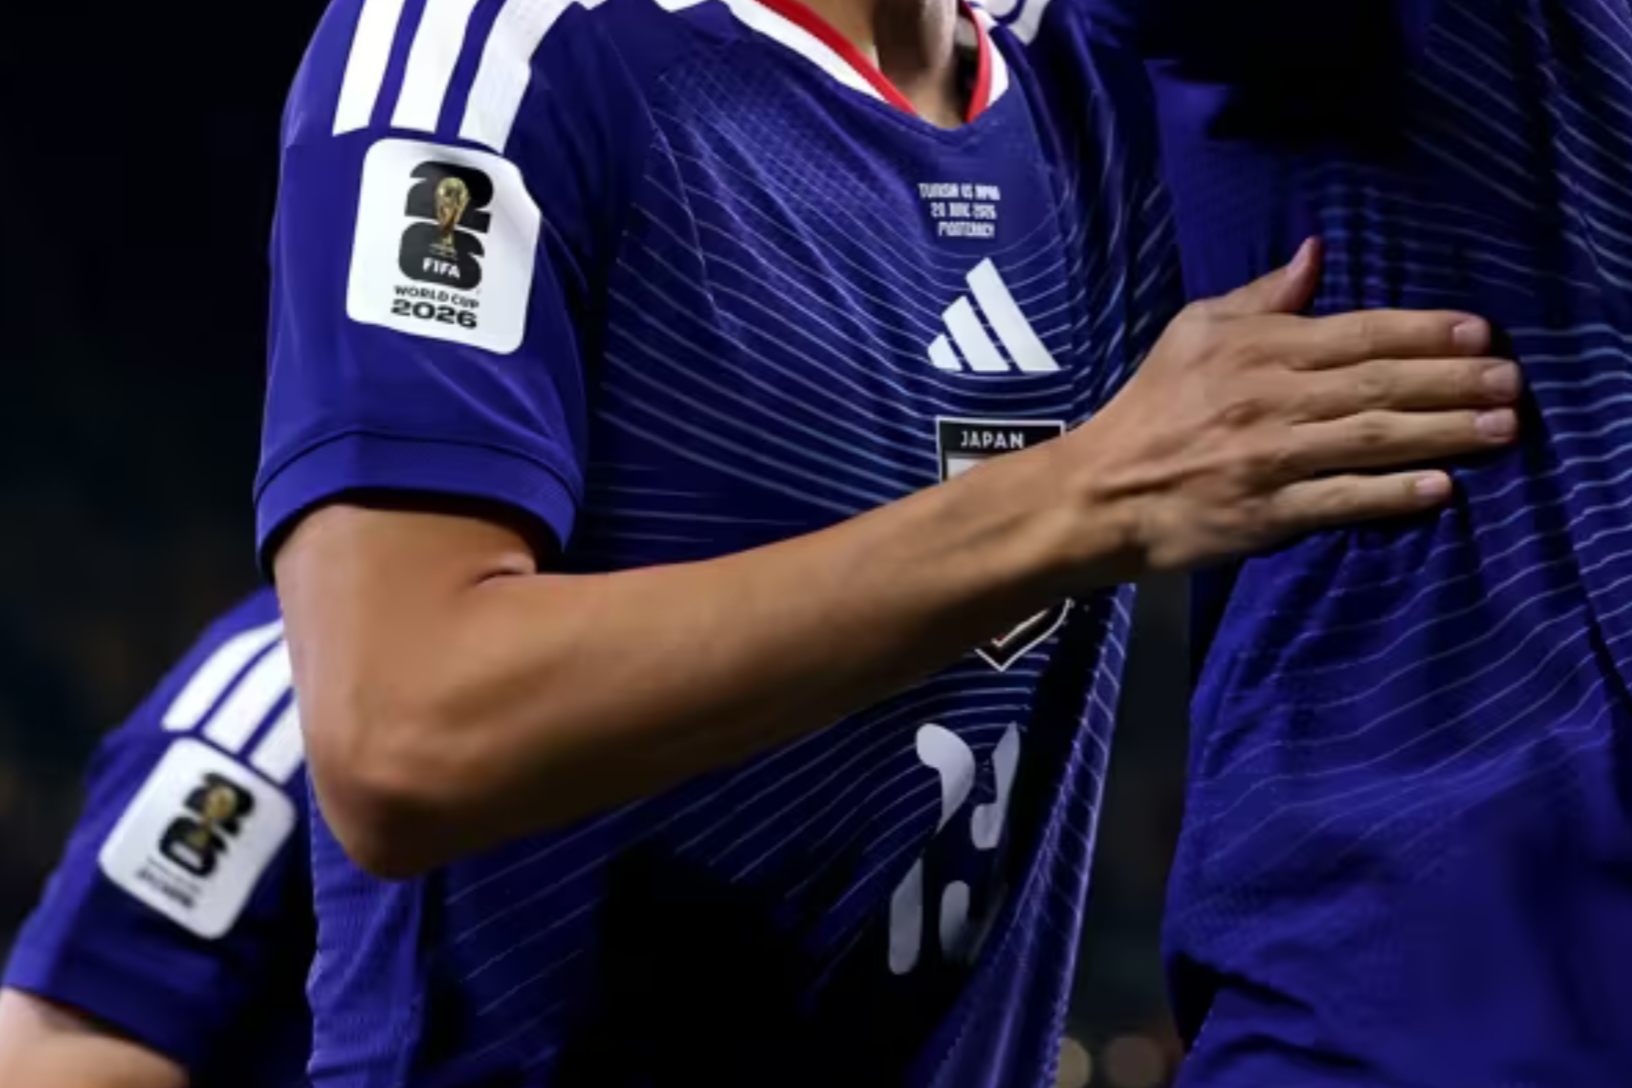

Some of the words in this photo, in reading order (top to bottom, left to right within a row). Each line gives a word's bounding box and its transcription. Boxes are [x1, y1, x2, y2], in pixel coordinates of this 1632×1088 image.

[423, 257, 461, 279] FIFA
[394, 285, 449, 302] WORLD
[451, 293, 480, 310] CUP
[390, 299, 478, 329] 2026
[961, 431, 1025, 449] JAPAN
